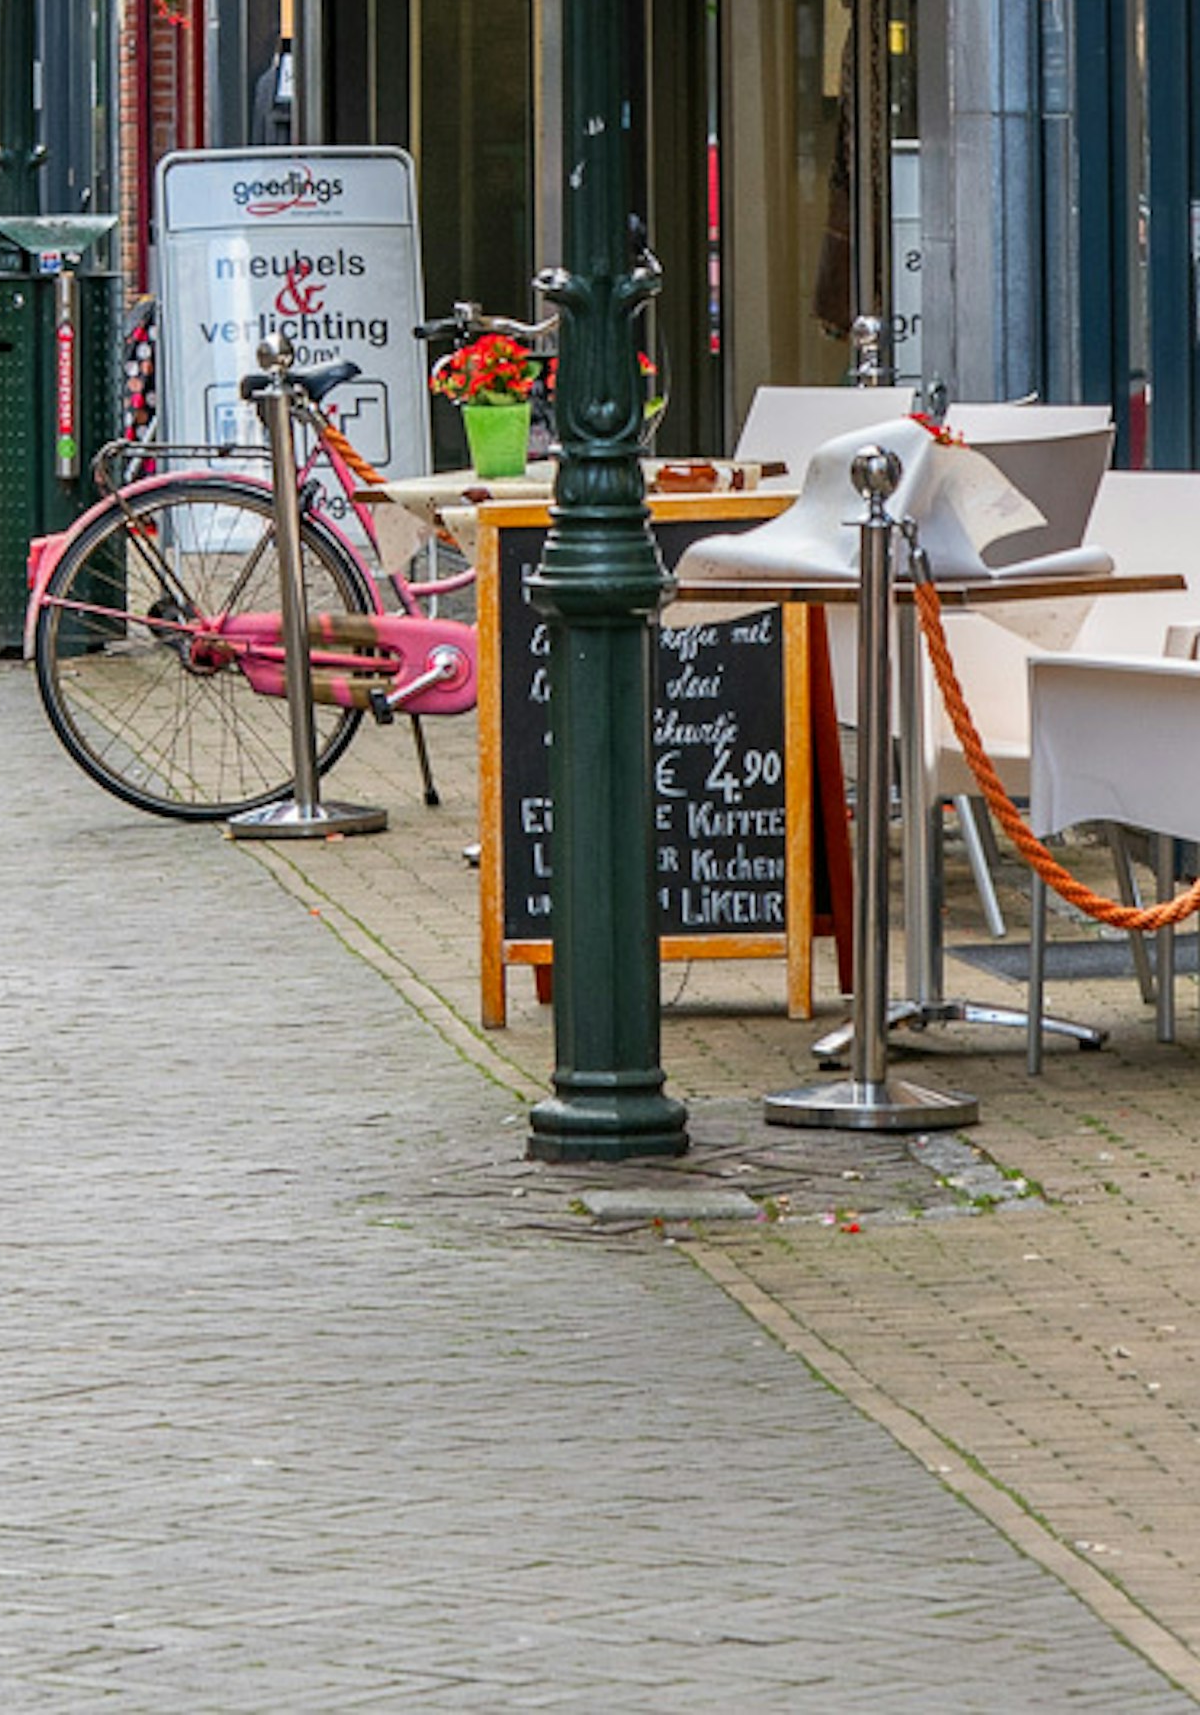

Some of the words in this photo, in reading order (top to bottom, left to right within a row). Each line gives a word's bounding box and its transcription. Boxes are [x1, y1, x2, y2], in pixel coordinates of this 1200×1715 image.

[233, 171, 343, 205] geerlings
[216, 249, 366, 279] meubels
[275, 261, 327, 316] &
[201, 312, 388, 347] verlichting
[656, 750, 688, 798] €
[705, 749, 782, 803] 4.90
